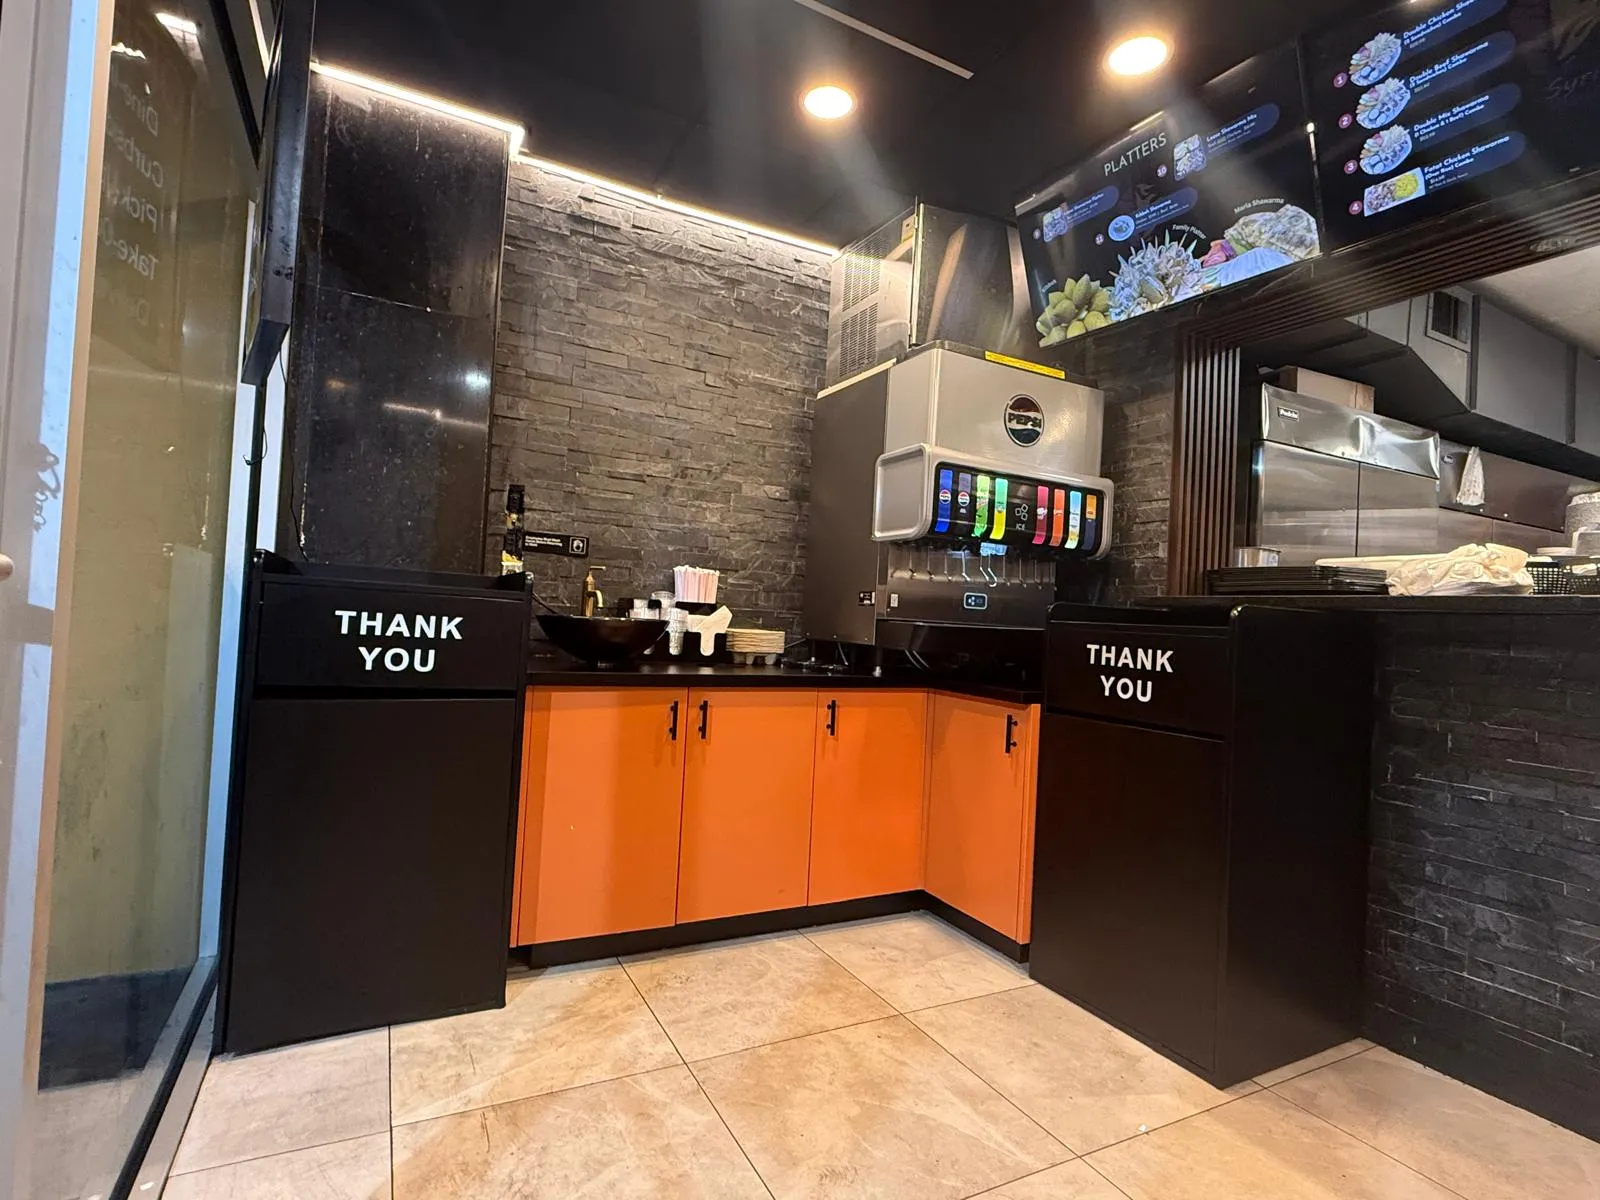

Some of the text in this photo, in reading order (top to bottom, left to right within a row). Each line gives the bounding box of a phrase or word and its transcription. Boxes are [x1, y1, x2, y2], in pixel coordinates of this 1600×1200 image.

[1104, 132, 1167, 177] PLATTERS
[1172, 224, 1190, 232] Family
[1008, 412, 1042, 429] PEPSI
[334, 609, 464, 640] THANK
[358, 646, 436, 673] YOU
[1086, 643, 1174, 673] THANK
[1100, 675, 1152, 703] YOU
